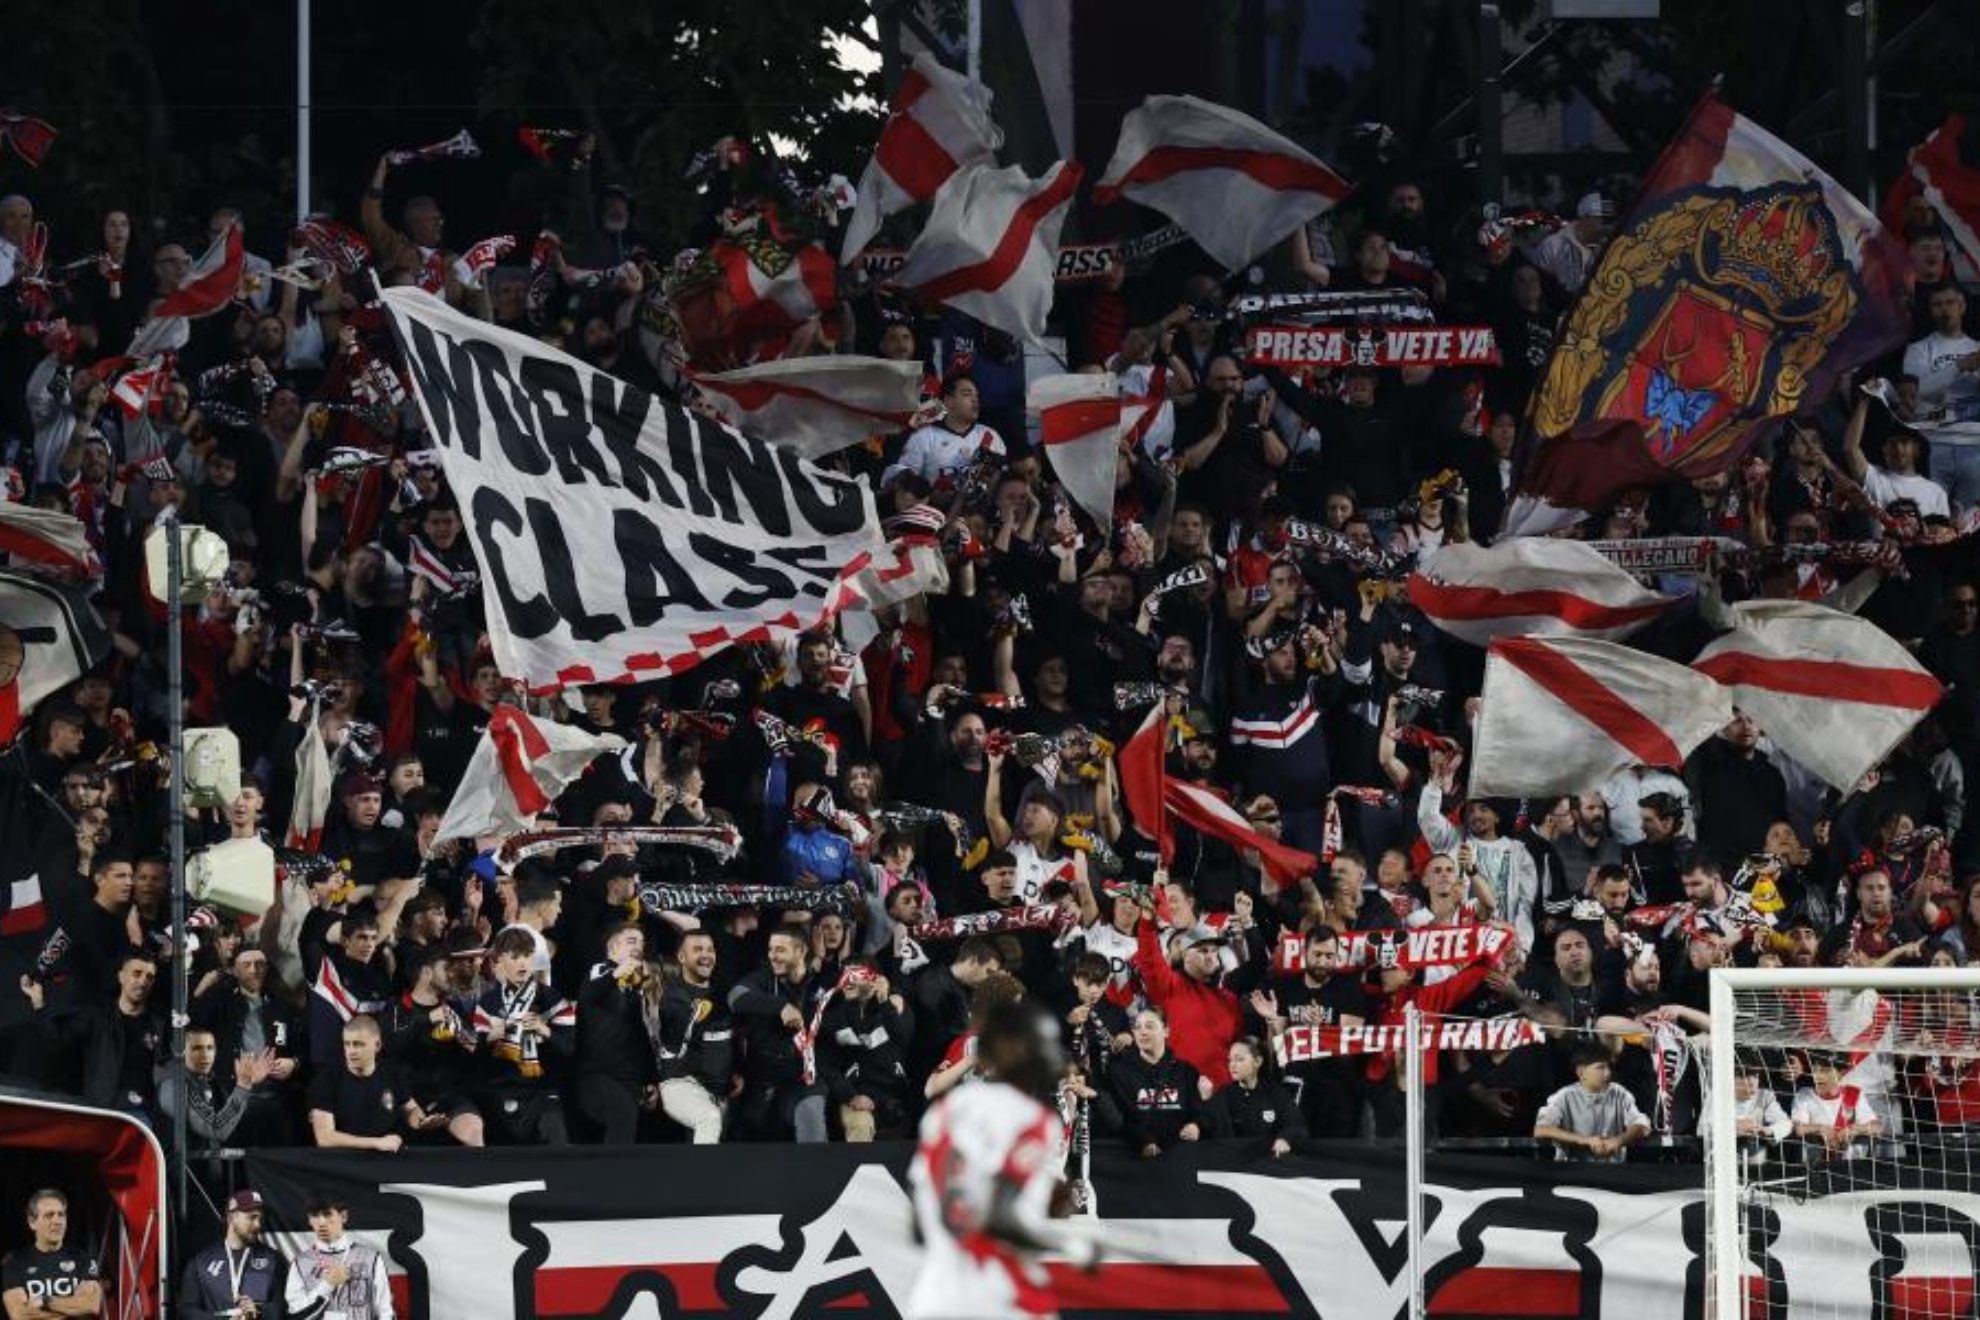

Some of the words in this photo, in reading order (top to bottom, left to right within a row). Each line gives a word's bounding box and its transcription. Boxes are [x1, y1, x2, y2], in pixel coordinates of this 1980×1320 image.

[1053, 250, 1112, 278] ASS
[1256, 331, 1341, 361] PRESA
[1387, 331, 1453, 361] VETE
[1459, 329, 1490, 359] YA
[406, 316, 867, 537] WORKING
[1283, 937, 1366, 969] PSA
[1408, 928, 1473, 962] VETE
